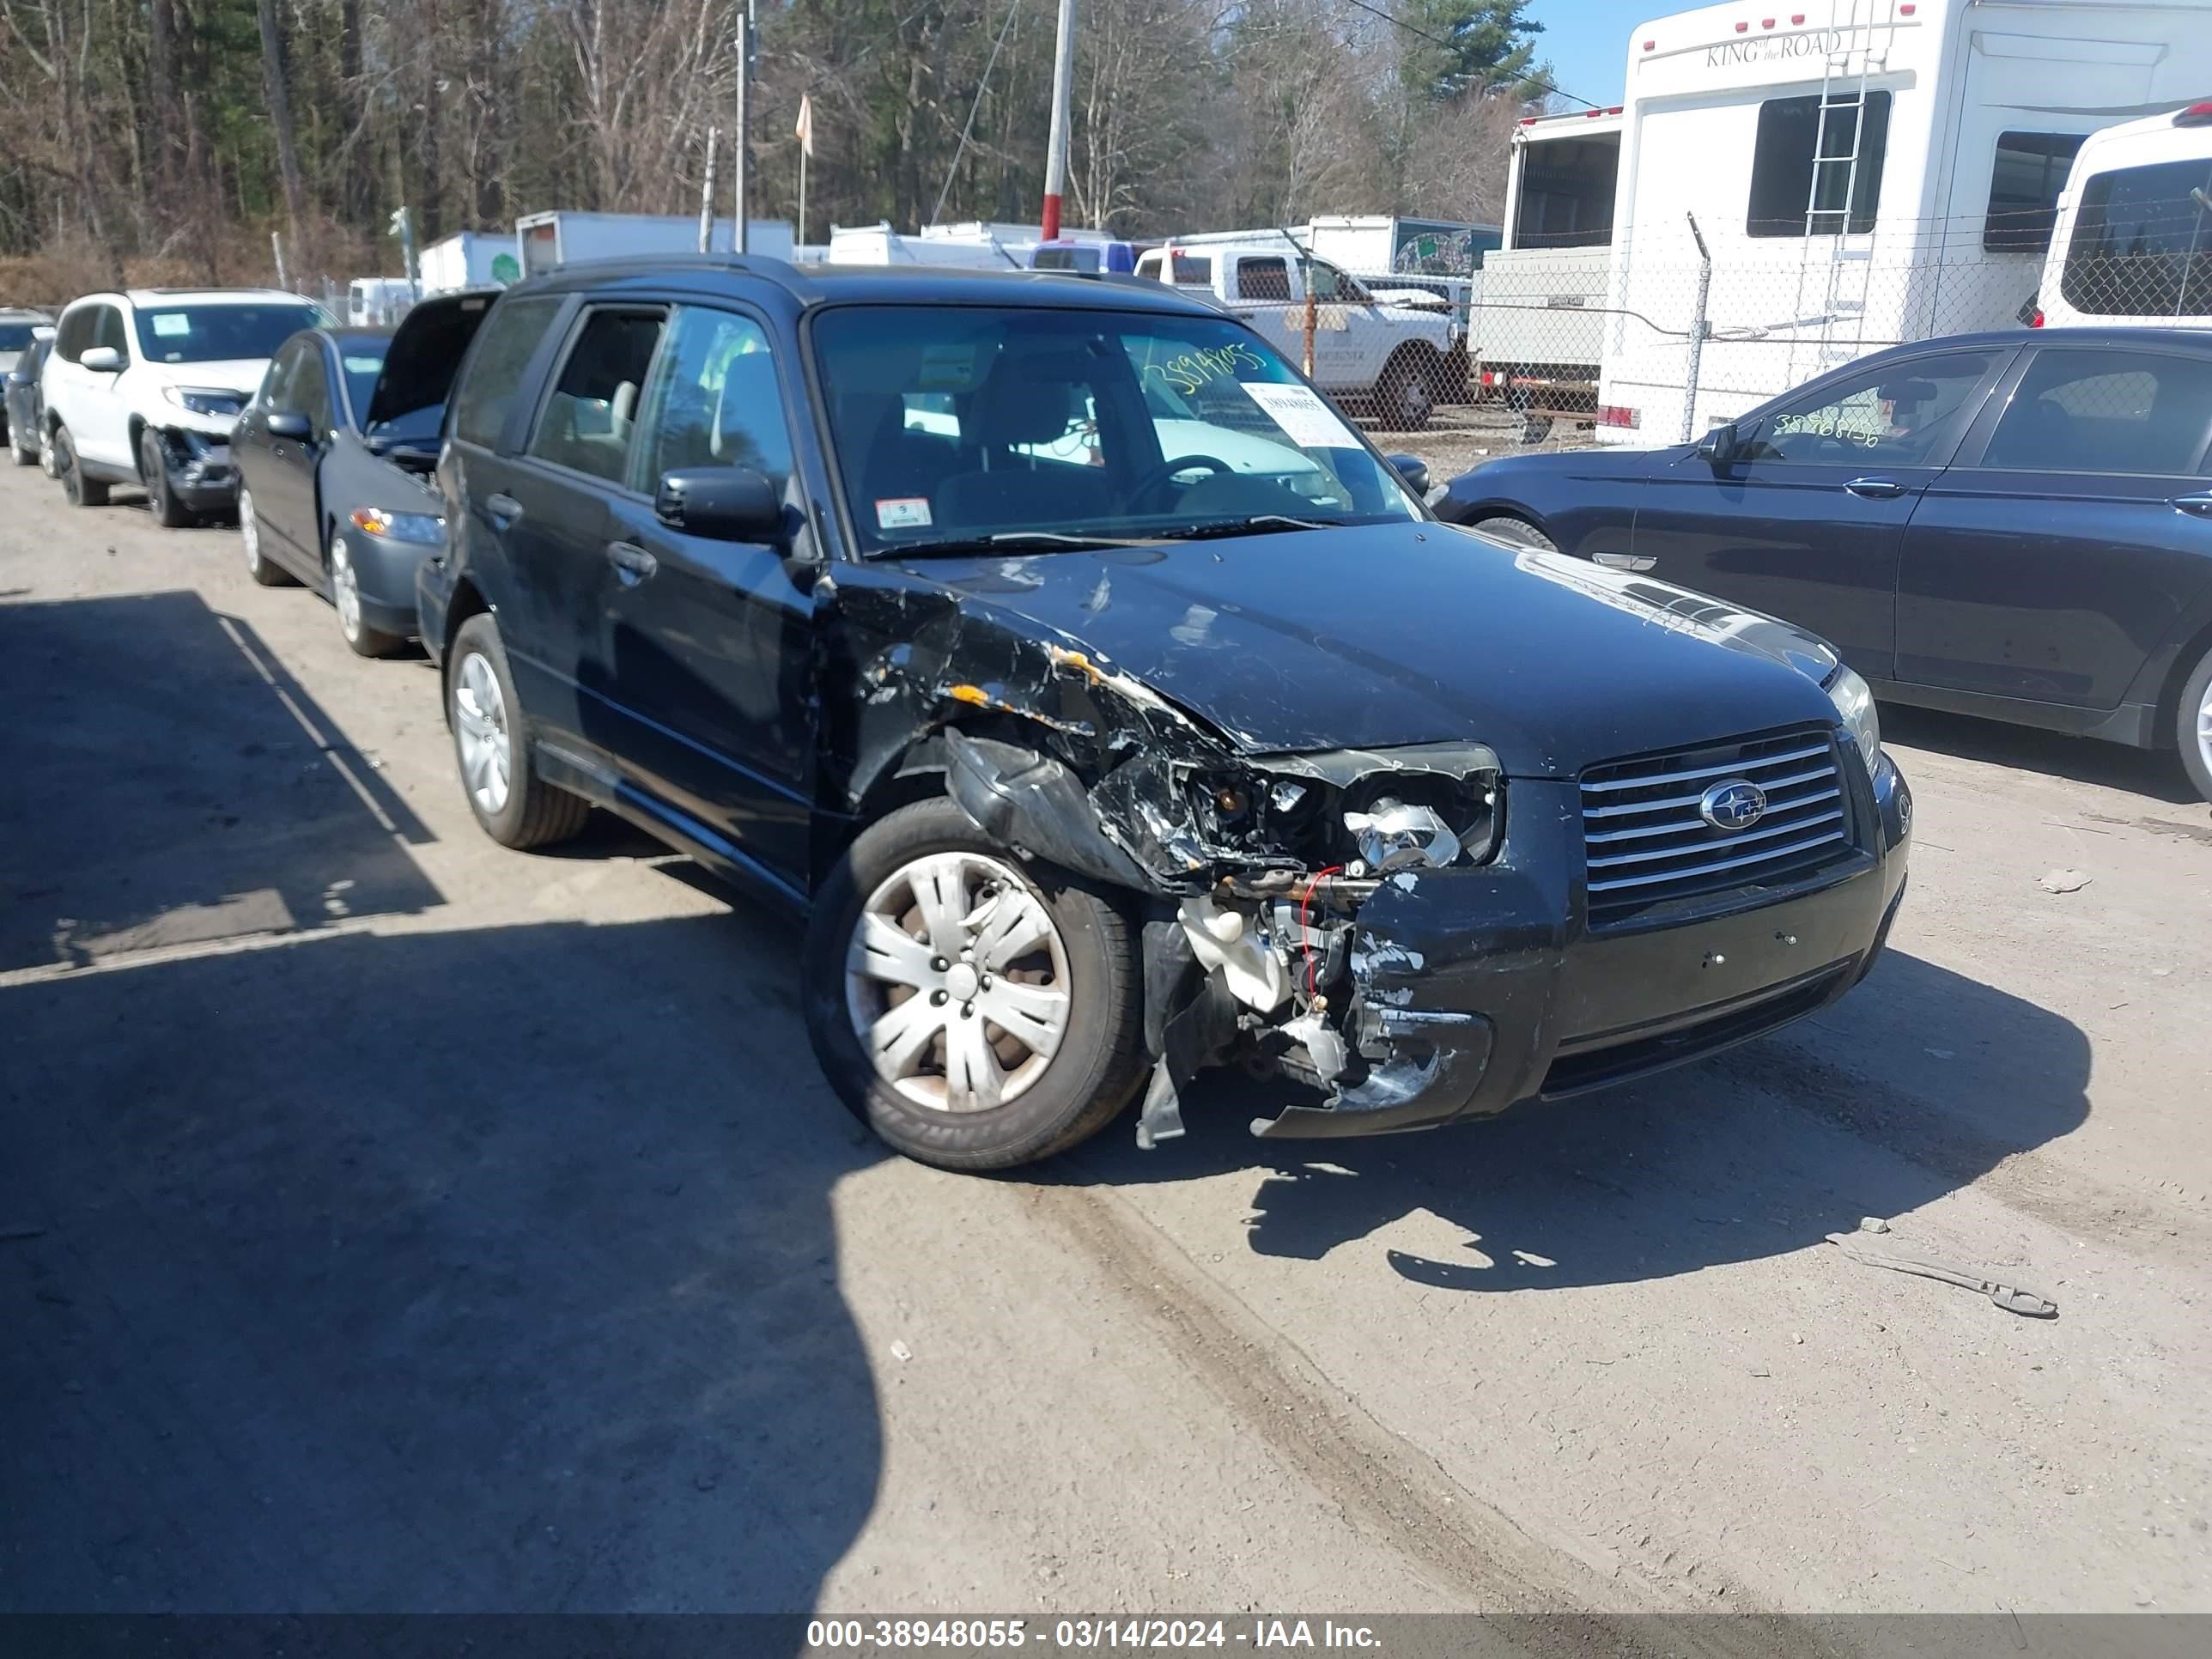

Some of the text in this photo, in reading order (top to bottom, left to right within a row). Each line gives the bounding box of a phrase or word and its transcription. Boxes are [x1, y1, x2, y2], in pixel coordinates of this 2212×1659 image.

[1707, 30, 1841, 67] KING of the ROAD
[1144, 343, 1267, 395] 38948055
[1263, 397, 1322, 411] 38948055
